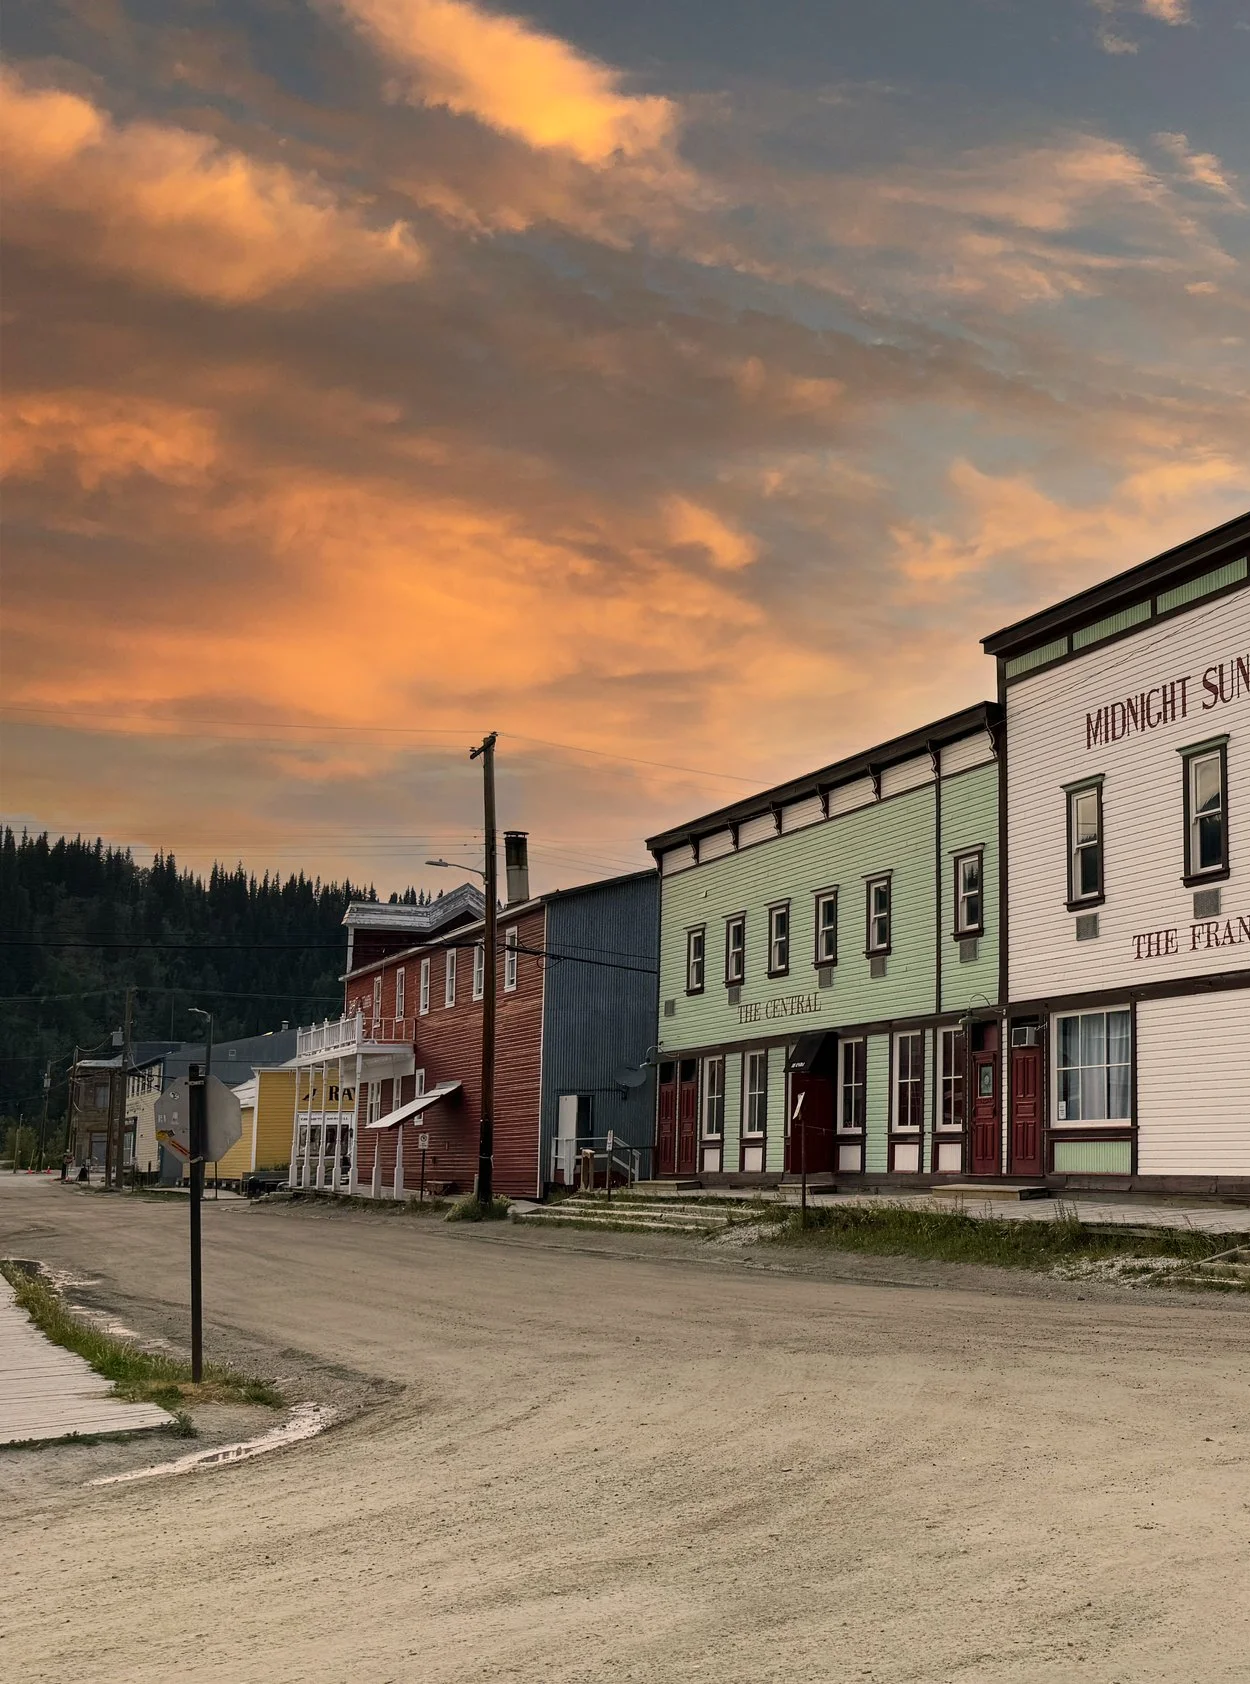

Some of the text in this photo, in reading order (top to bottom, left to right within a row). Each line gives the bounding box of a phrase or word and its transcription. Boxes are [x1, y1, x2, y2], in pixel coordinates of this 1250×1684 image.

[1086, 676, 1192, 750] MIDNIGHT
[1202, 653, 1250, 710] SUN
[1131, 927, 1178, 960] THE
[737, 992, 822, 1024] THE CENTRAL
